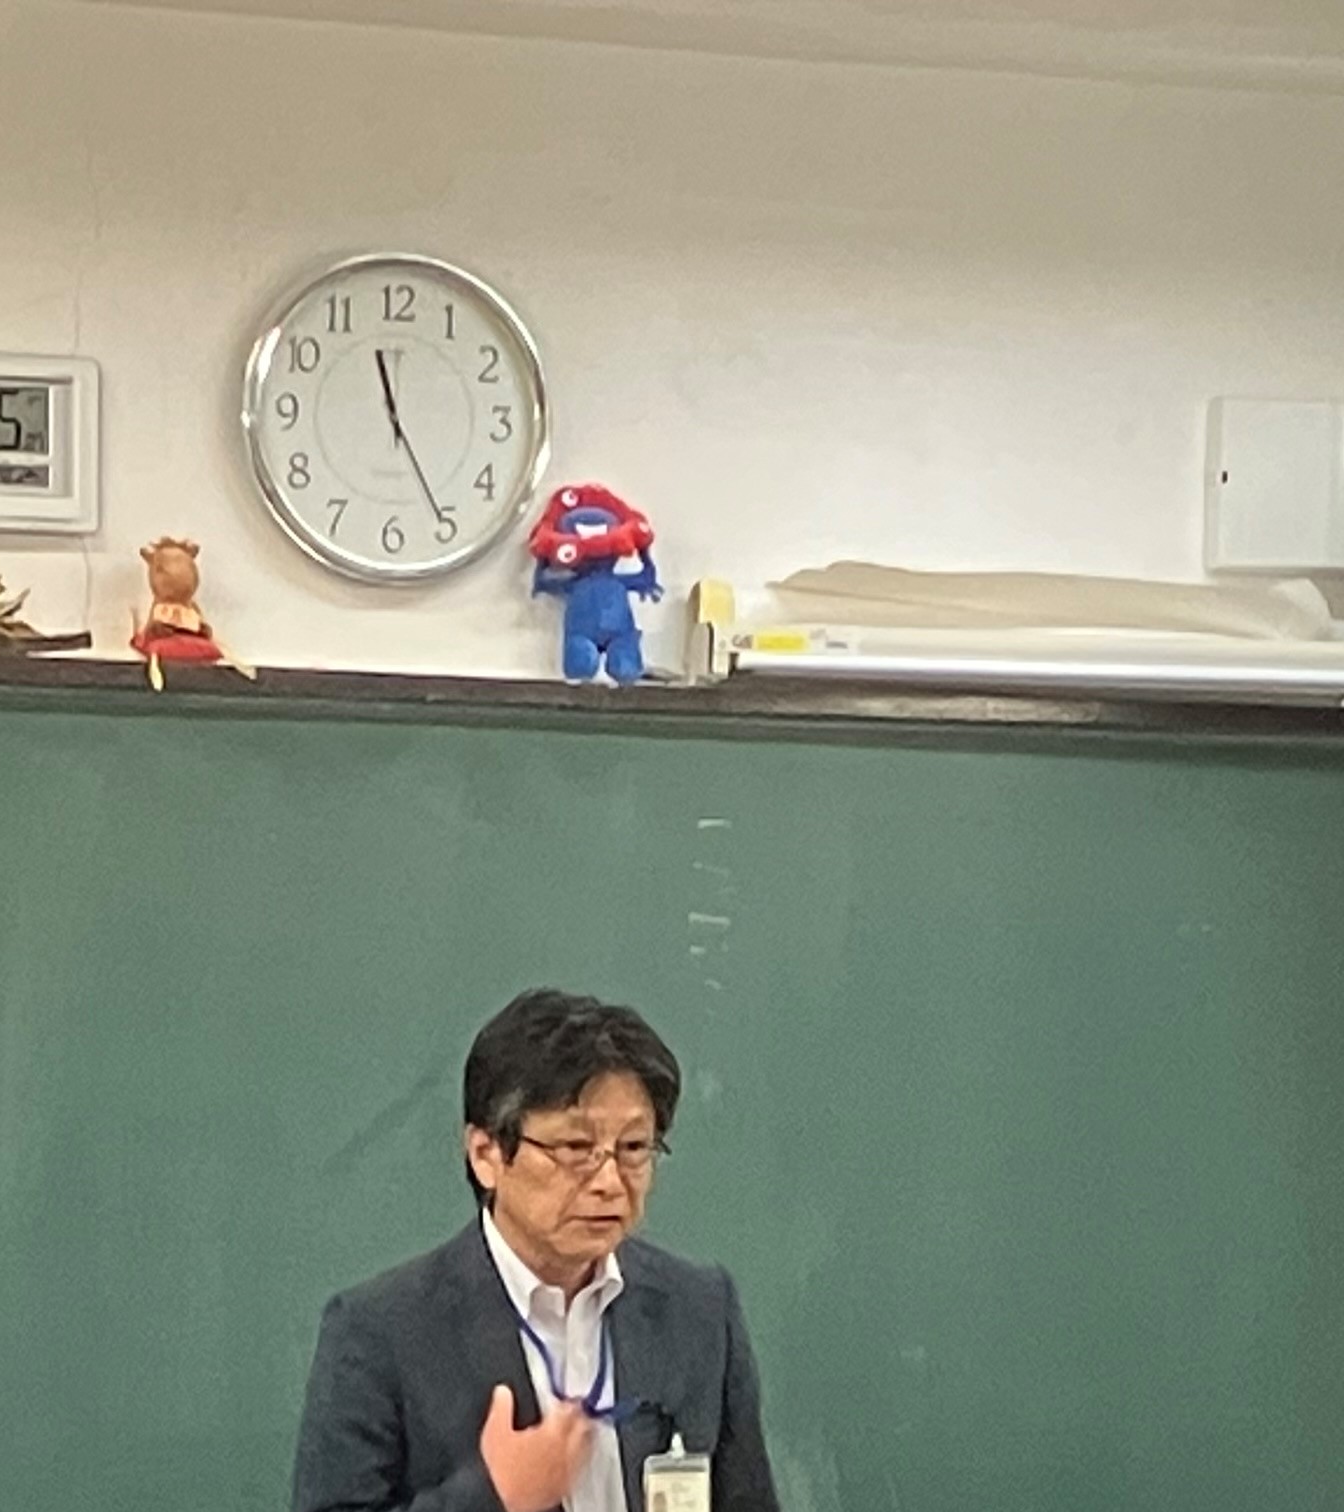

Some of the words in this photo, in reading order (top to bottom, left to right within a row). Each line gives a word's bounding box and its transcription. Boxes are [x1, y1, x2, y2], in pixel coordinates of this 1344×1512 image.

[327, 296, 352, 334] 11
[382, 284, 416, 322] 12
[444, 304, 456, 340] 1
[287, 336, 320, 373] 10
[477, 345, 500, 384] 2
[275, 393, 299, 431] 9
[489, 405, 513, 443] 3
[287, 452, 312, 490] 8
[473, 463, 495, 501] 4
[326, 499, 348, 537] 7
[381, 516, 405, 554] 6
[434, 506, 458, 544] 5
